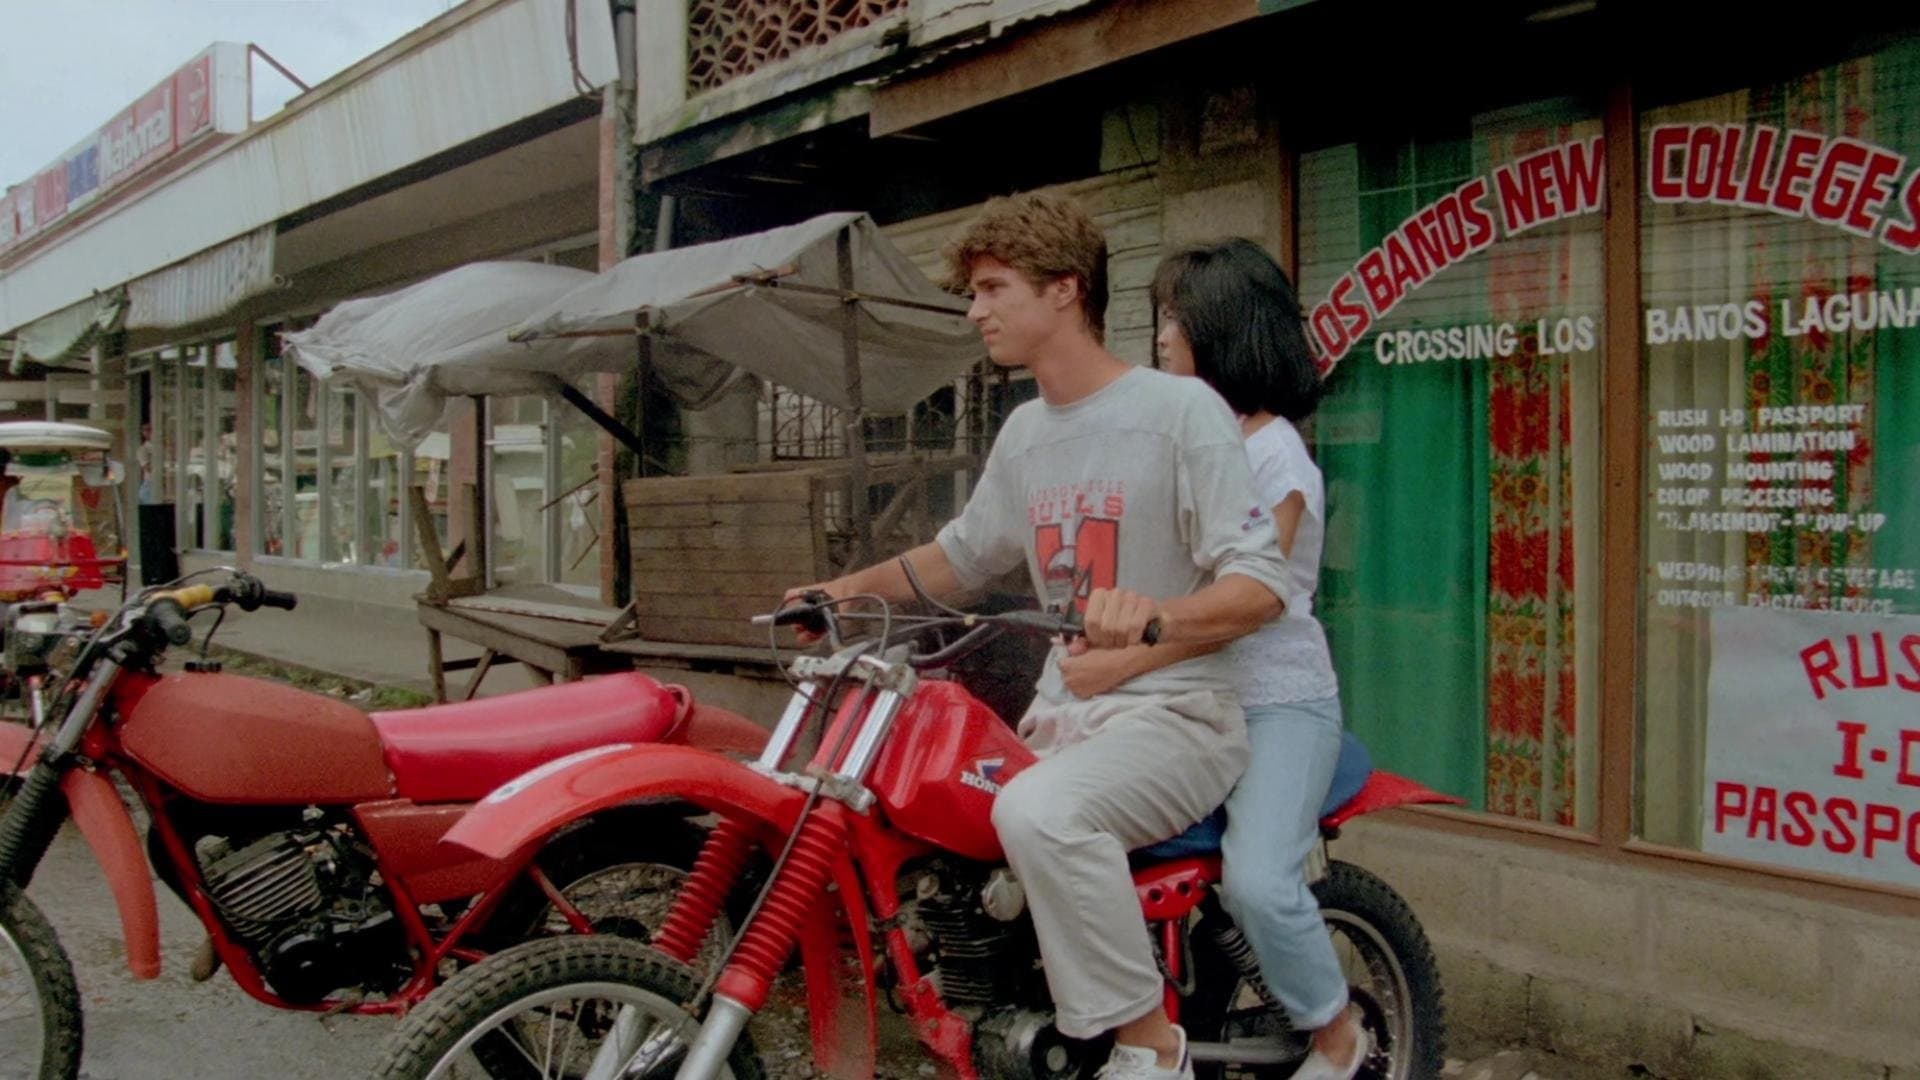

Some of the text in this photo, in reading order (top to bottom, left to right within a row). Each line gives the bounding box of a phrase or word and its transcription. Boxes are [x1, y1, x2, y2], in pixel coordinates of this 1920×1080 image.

[1494, 136, 1606, 237] NEW
[1376, 315, 1595, 365] CROSSING LOS
[1658, 409, 1708, 427] RUSH
[1758, 405, 1865, 426] PASSPORT
[1658, 431, 1854, 453] WOOD LAMINATION
[1658, 461, 1834, 481] WOOD MOUNTING
[1721, 487, 1835, 508] PROCESSING
[961, 770, 1002, 795] HON
